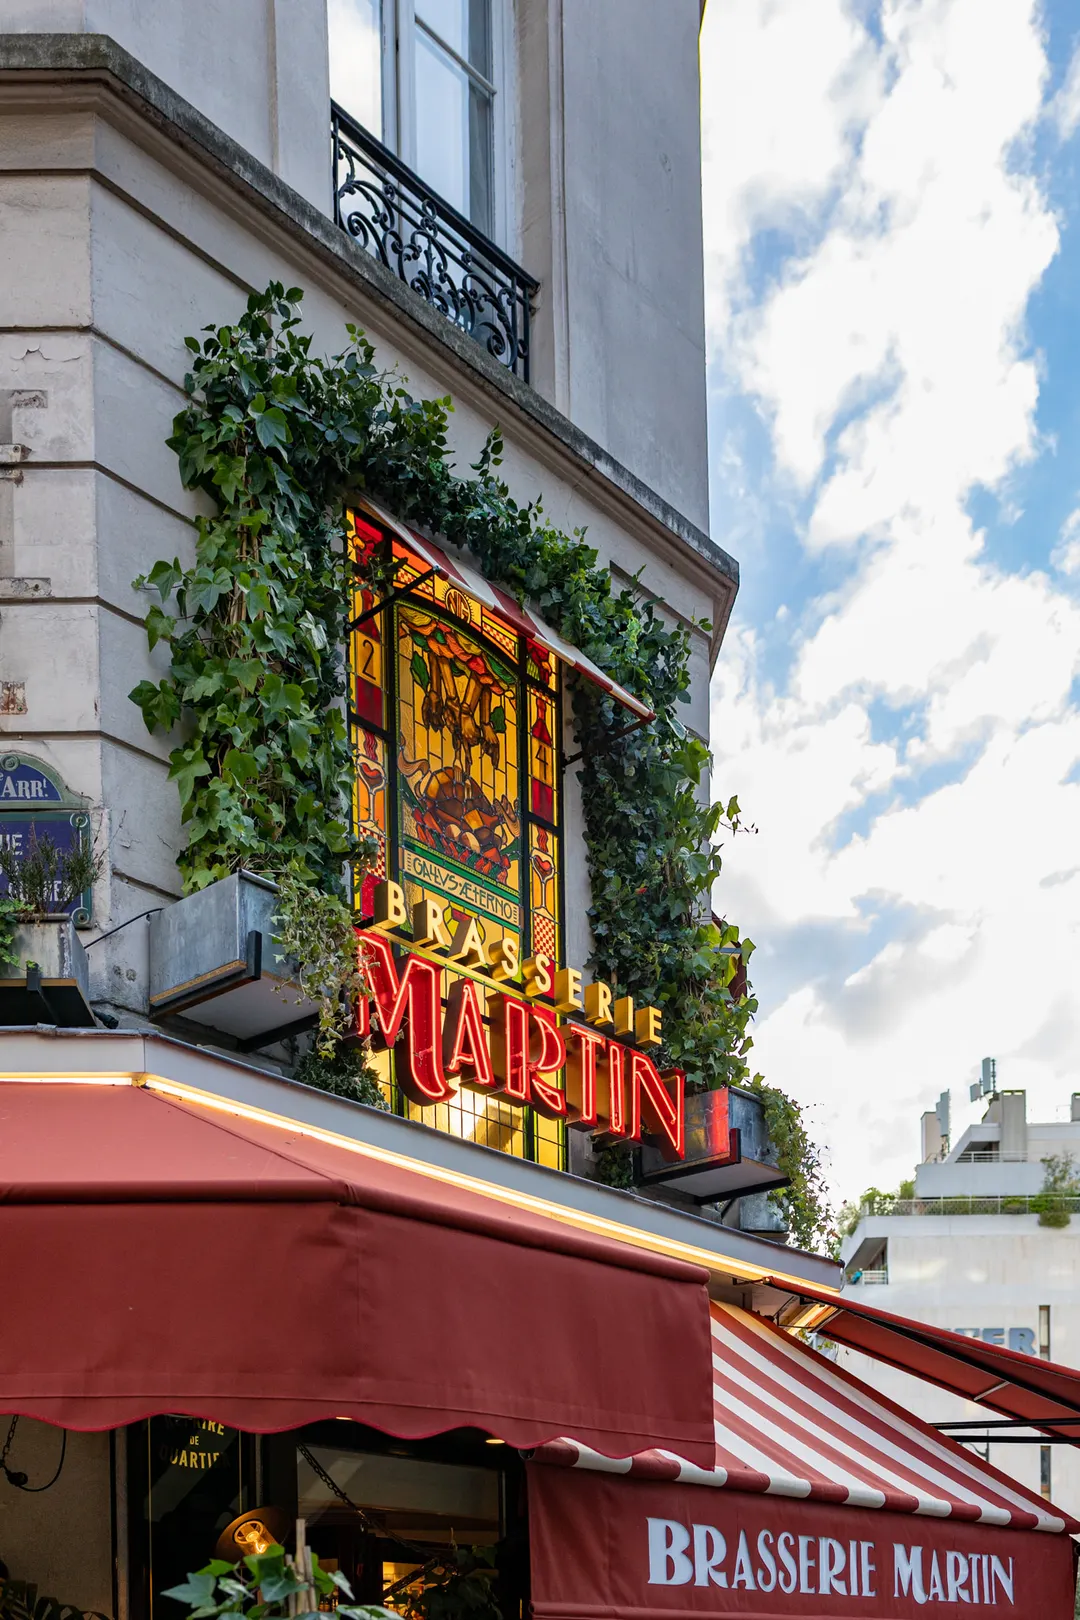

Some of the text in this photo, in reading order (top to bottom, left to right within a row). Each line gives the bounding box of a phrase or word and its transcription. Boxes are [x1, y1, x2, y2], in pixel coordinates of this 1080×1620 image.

[362, 638, 377, 682] 2
[534, 744, 549, 777] 4
[376, 880, 663, 1048] BRASSERIE
[357, 926, 686, 1161] MARTIN
[646, 1516, 1015, 1606] BRASSERIE MARTIN
